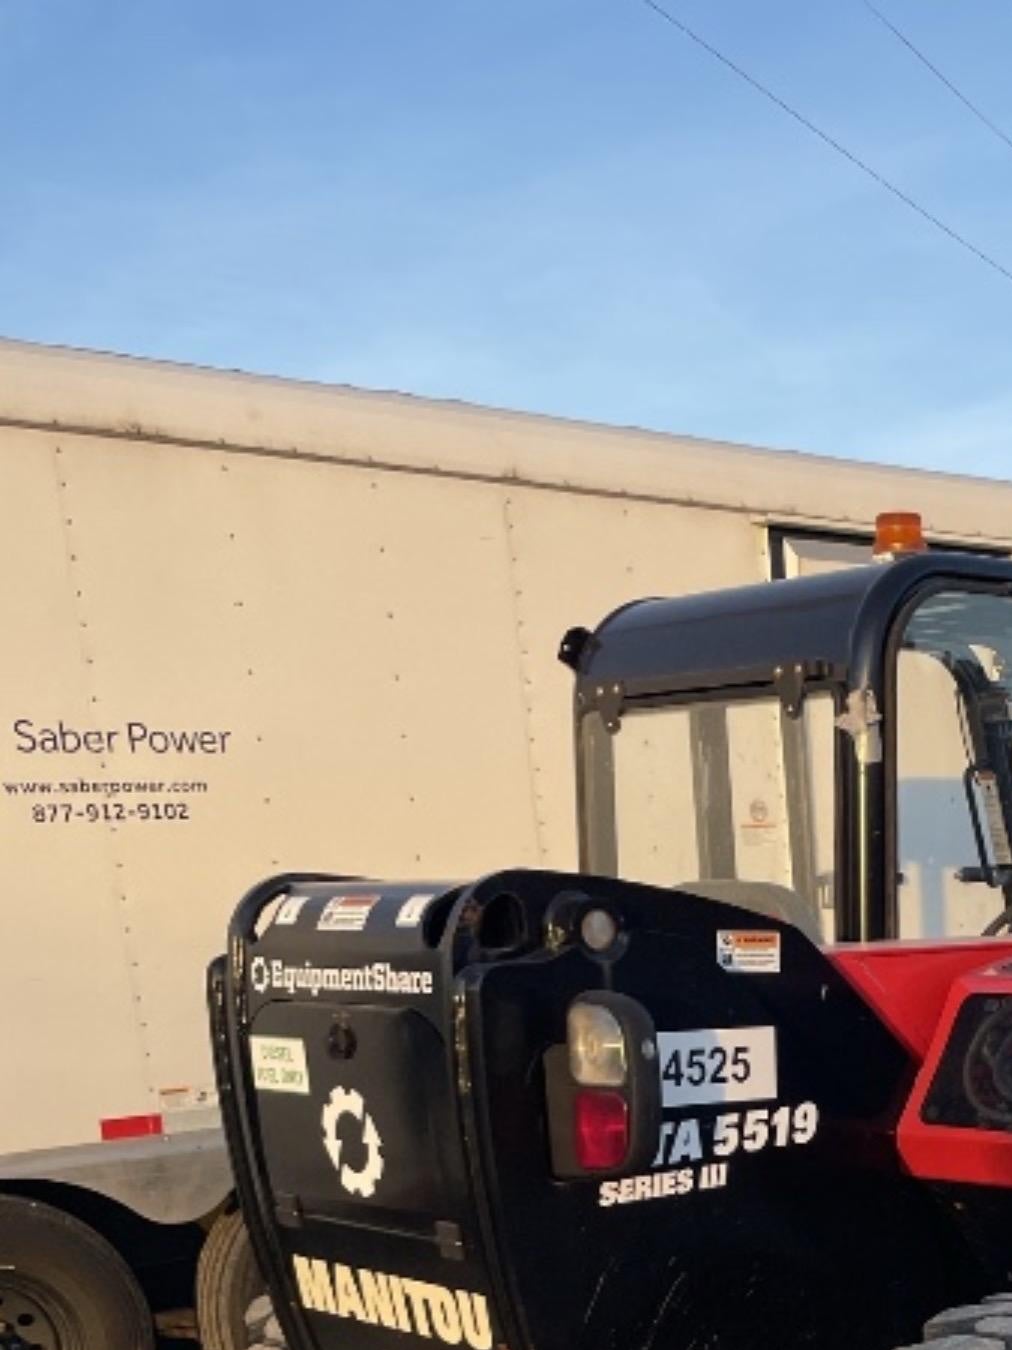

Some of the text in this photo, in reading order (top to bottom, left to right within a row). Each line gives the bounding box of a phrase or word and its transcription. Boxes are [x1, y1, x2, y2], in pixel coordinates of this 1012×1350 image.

[13, 719, 231, 753] Saber Power
[3, 779, 208, 797] www.saberpower.com
[32, 803, 190, 823] 877-912-9102
[270, 959, 433, 996] EquipmentShare
[662, 1046, 751, 1086] 4525
[652, 1101, 818, 1167] TA 5519
[599, 1167, 694, 1207] SERIES
[293, 1253, 492, 1350] MANITOU
